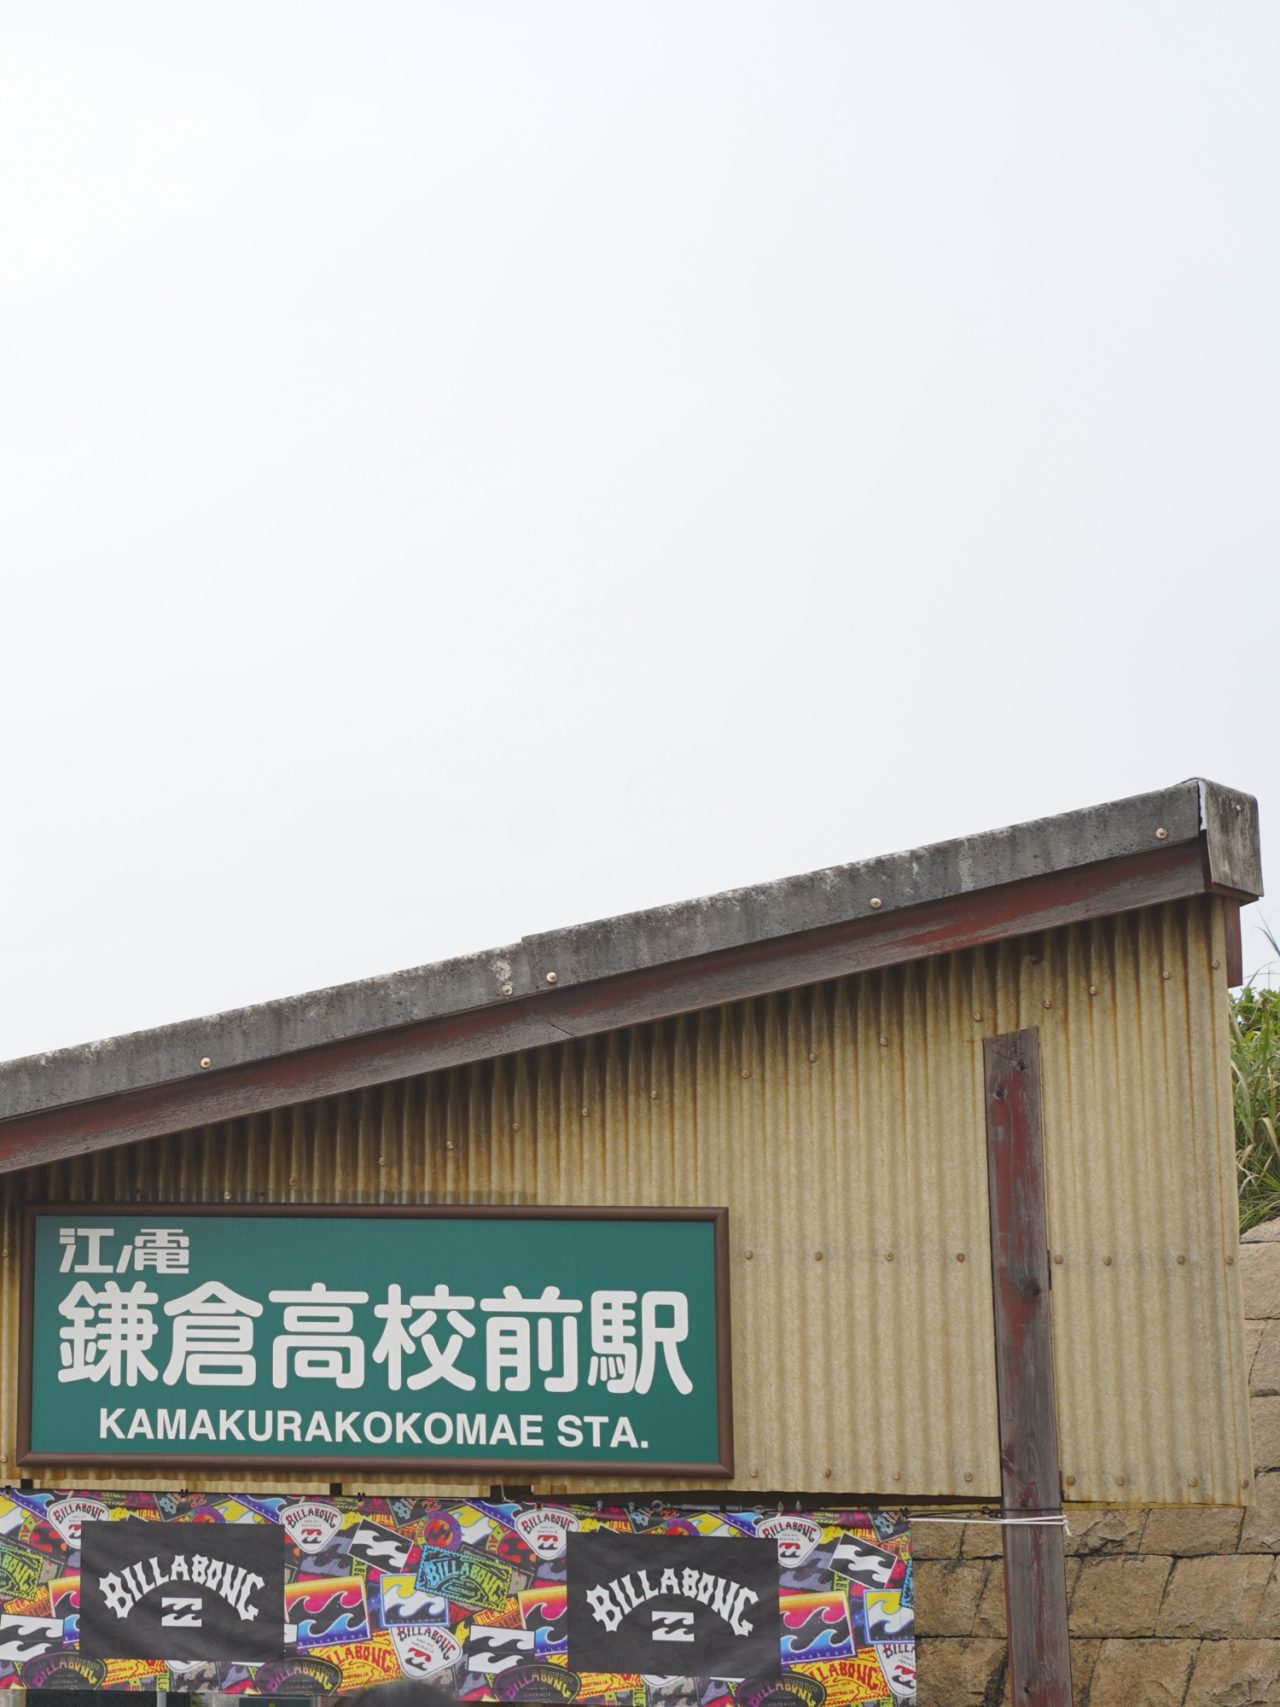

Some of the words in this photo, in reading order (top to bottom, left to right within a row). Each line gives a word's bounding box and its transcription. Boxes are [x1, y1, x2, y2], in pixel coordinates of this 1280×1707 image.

[57, 1279, 695, 1396] 鎌倉高校前駅
[98, 1407, 545, 1448] KAMAKURAKOKOMAE
[557, 1415, 650, 1449] STA.
[285, 1507, 339, 1529] BILLABONG
[98, 1553, 265, 1622] BILLABONG
[426, 1559, 504, 1604] BILLABONG
[586, 1566, 760, 1637] BILLABONG
[397, 1626, 457, 1661] BILLABONG
